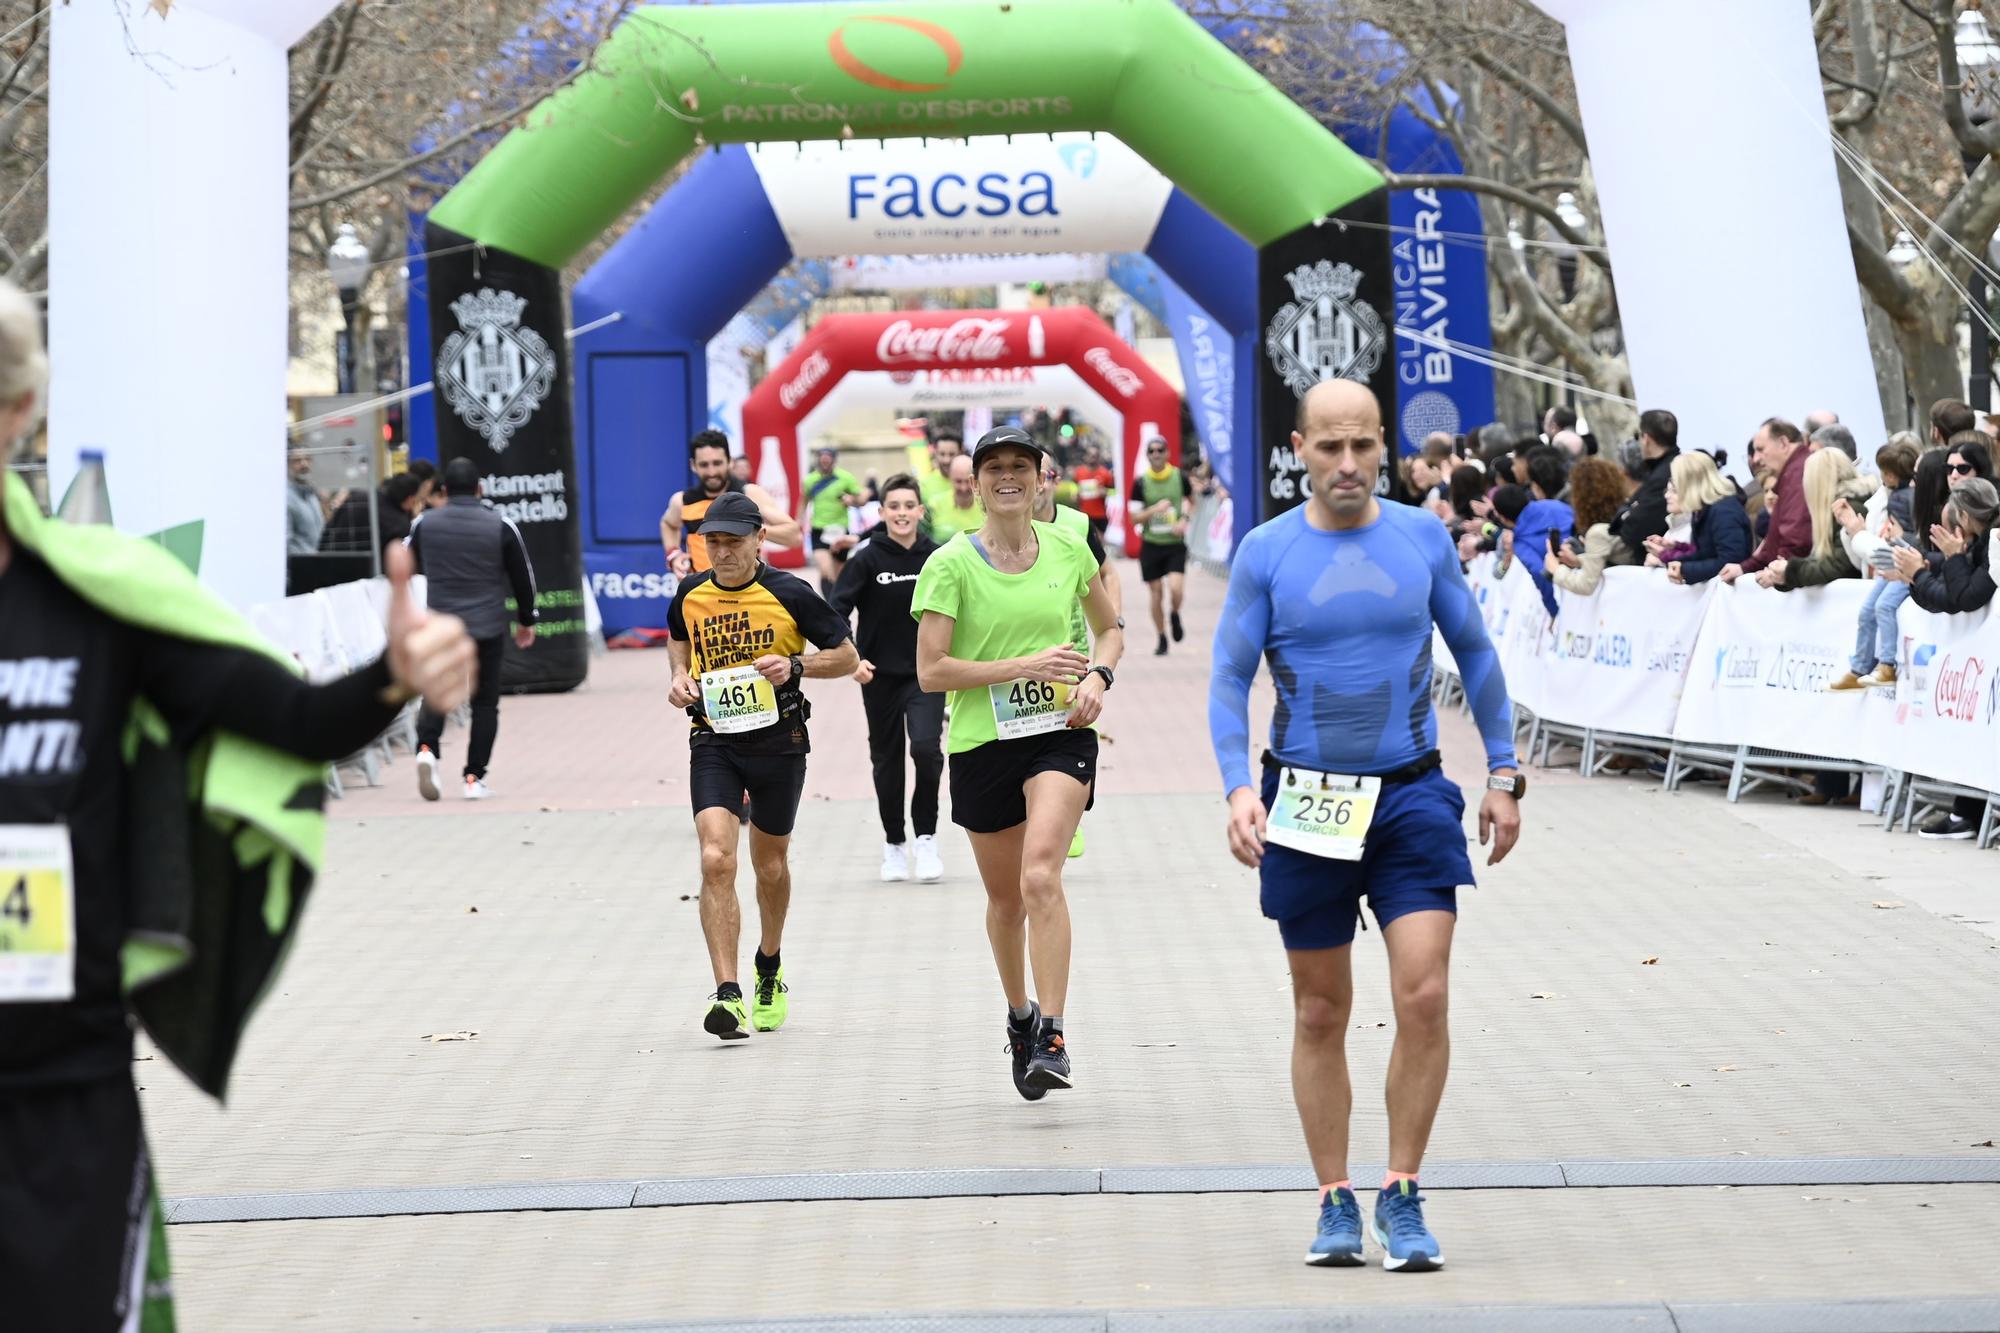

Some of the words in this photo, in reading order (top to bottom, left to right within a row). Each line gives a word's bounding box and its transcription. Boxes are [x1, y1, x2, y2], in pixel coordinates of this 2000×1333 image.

[722, 101, 883, 124] PATRONAT
[897, 96, 1074, 119] D'ESPORTS
[1414, 187, 1453, 384] BAVIERA
[1393, 238, 1423, 385] CLNICA
[478, 469, 565, 497] ntament
[1270, 471, 1296, 499] de
[481, 494, 568, 523] astelló
[709, 655, 729, 670] SANT
[718, 683, 757, 708] 461
[1008, 680, 1055, 707] 466
[718, 703, 765, 719] FRANCESC
[1014, 702, 1055, 719] AMPARO
[1293, 795, 1353, 825] 256
[1296, 822, 1341, 836] TORCIS
[3, 874, 33, 926] 4
